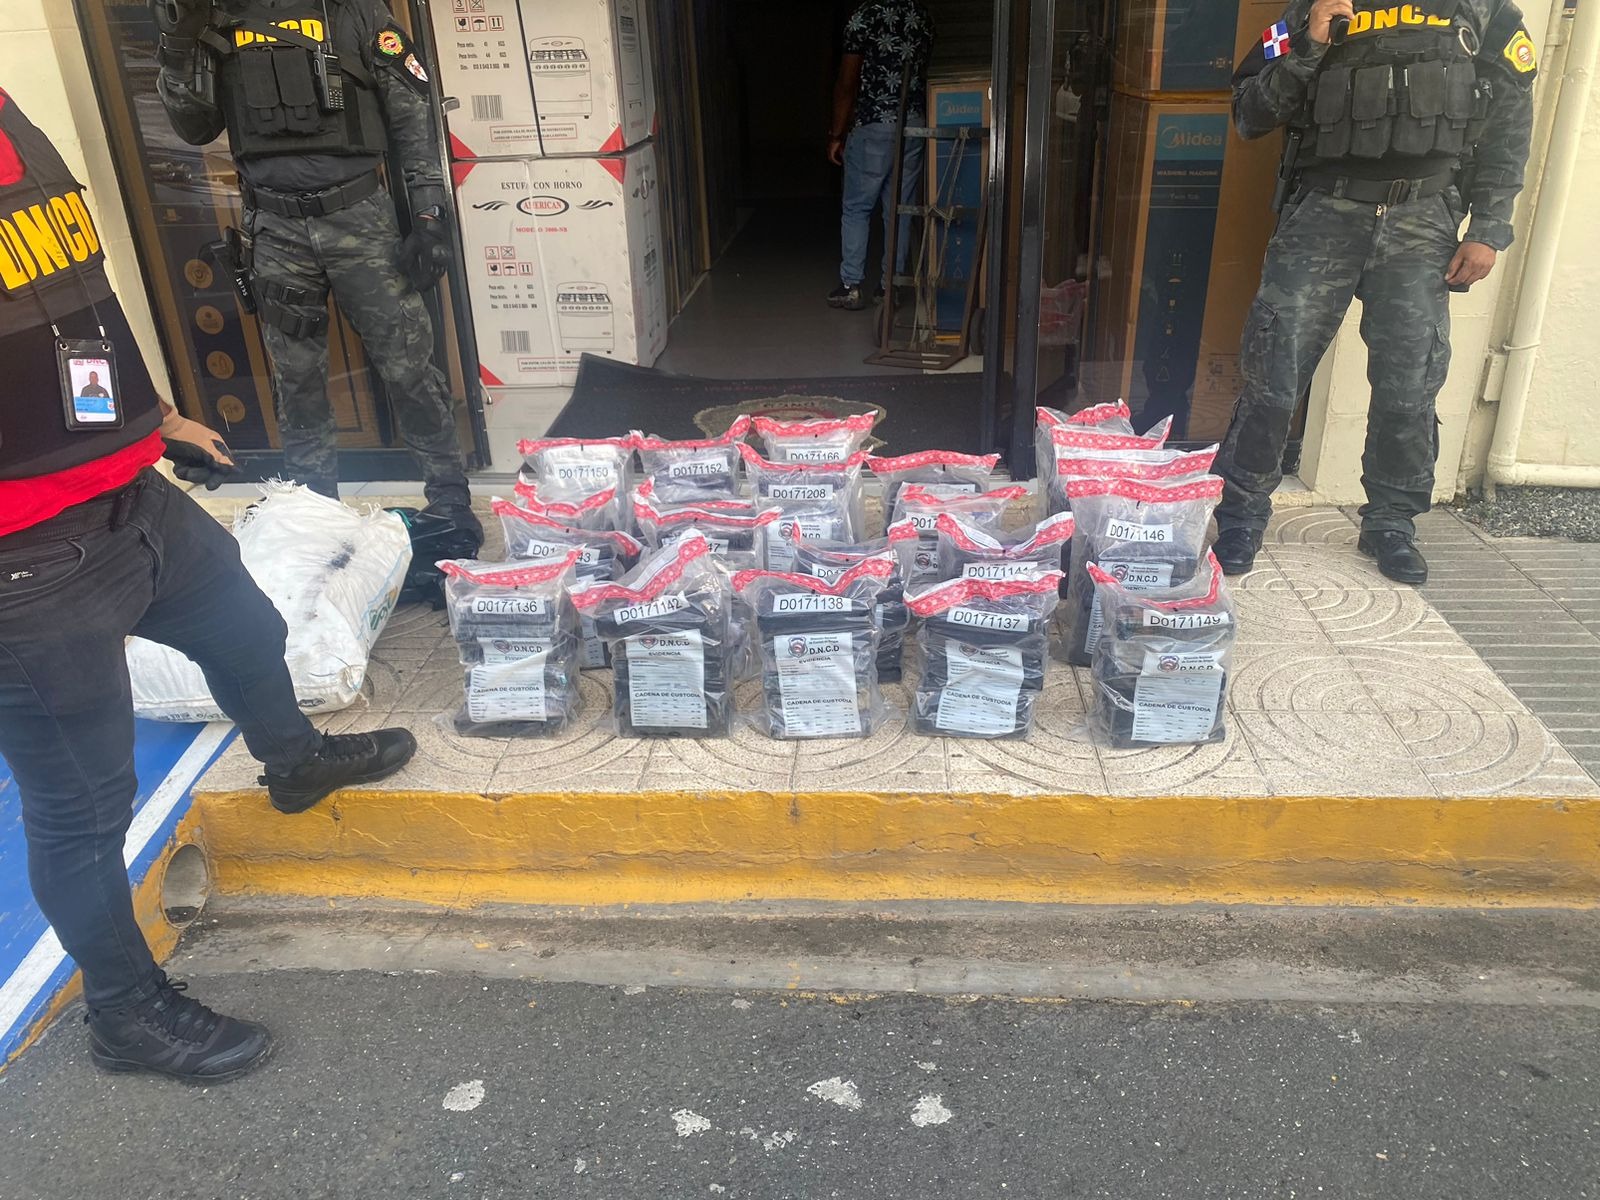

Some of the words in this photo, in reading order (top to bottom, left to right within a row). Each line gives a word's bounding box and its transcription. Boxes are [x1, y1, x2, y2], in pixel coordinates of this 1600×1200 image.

[1164, 128, 1223, 148] Midea
[533, 181, 550, 189] CON
[553, 181, 583, 189] HORNO
[0, 191, 99, 290] DNCD
[790, 452, 839, 461] D0171166
[559, 467, 608, 479] D0171150
[673, 463, 722, 477] D0171152
[773, 489, 826, 499] D0171208
[1110, 524, 1165, 541] D0171146
[477, 600, 537, 612] D0171136
[620, 598, 682, 621] D0171142
[780, 598, 844, 610] D0171138
[954, 610, 1020, 629] D0171137
[1150, 615, 1220, 628] D0171149
[809, 645, 839, 655] D.N.C.D
[981, 696, 1011, 706] CUSTODIA
